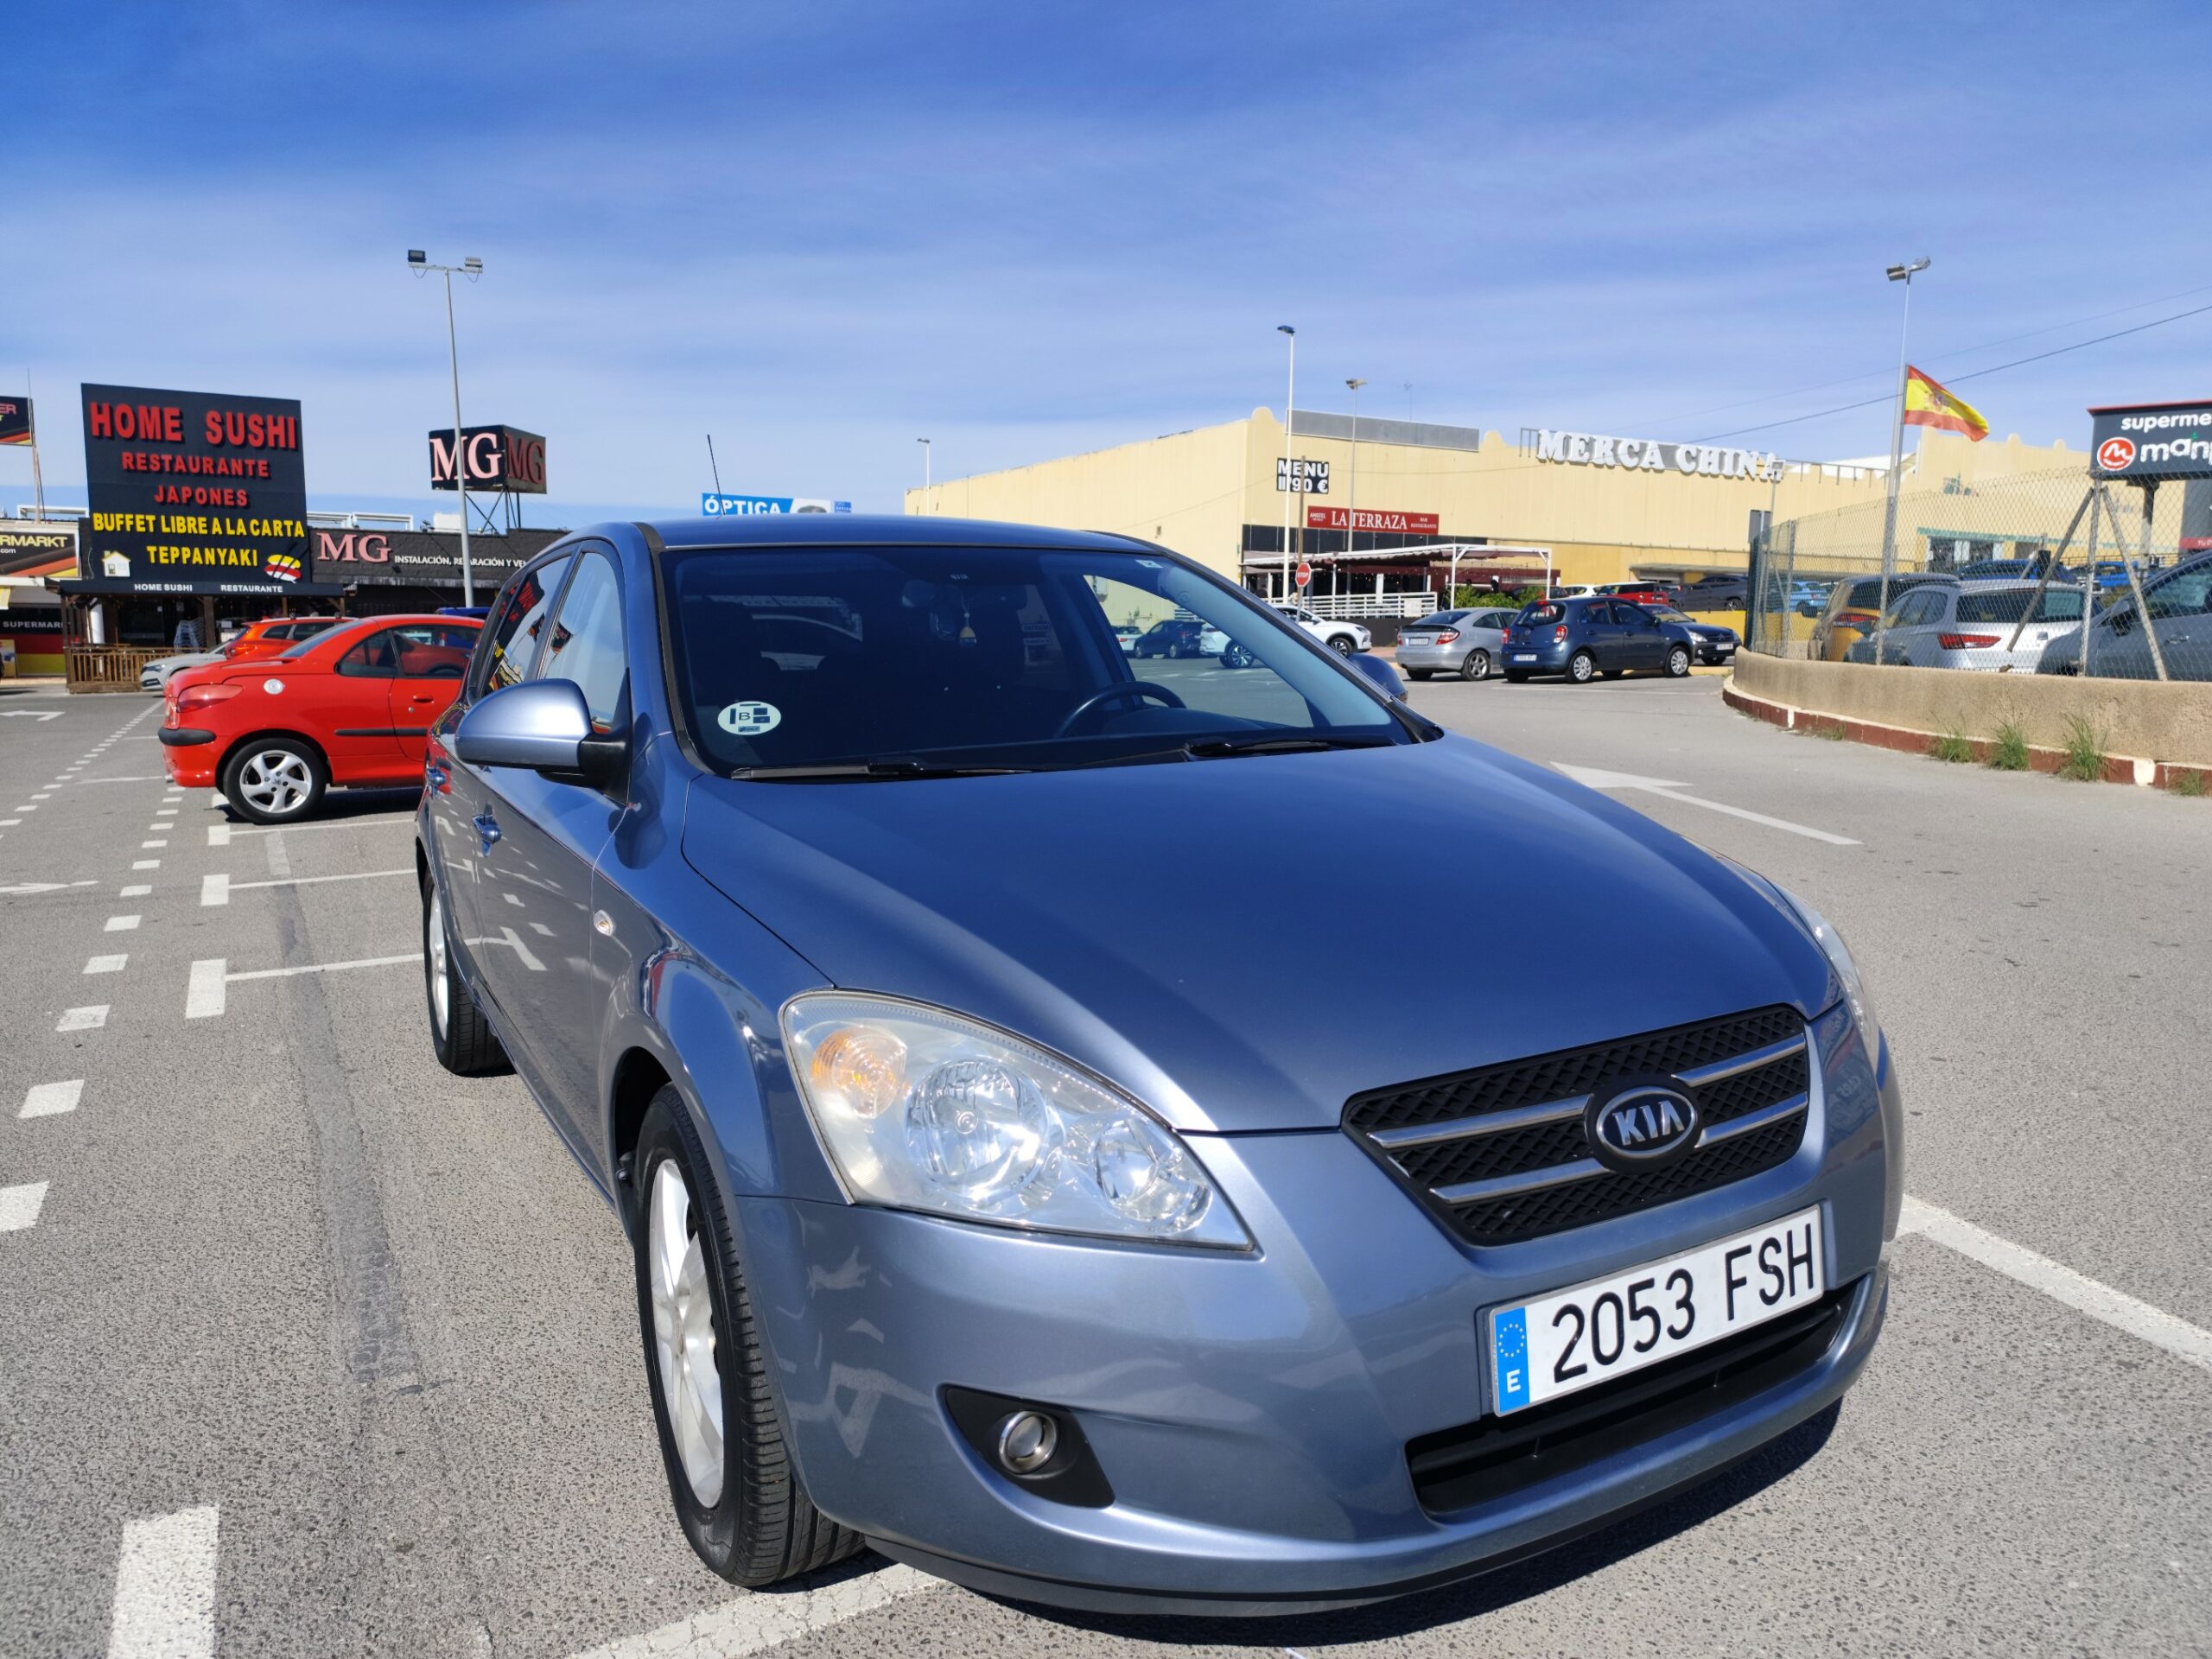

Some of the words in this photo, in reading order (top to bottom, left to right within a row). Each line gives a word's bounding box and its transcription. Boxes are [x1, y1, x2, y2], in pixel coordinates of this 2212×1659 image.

[90, 402, 182, 442] HOME
[206, 410, 296, 449] SUSHI
[122, 452, 270, 477] RESTAURANTE
[429, 433, 502, 481] MG
[505, 434, 545, 485] MG
[1538, 429, 1665, 471] MERCA
[1675, 443, 1785, 482] CHINA
[154, 485, 248, 506] JAPONES
[1318, 479, 1328, 493] €
[704, 495, 782, 514] ÓPTICA
[92, 512, 156, 532] BUFFET
[161, 515, 208, 534] LIBRE
[212, 518, 223, 535] A
[226, 518, 249, 536] LA
[250, 518, 304, 537] CARTA
[1332, 511, 1347, 526] LA
[1351, 512, 1408, 530] TERRAZA
[147, 546, 257, 566] TEPPANYAKI
[316, 532, 391, 563] MG
[394, 556, 452, 566] INSTALACIÓN,
[454, 557, 505, 567] REARACIÓN
[134, 583, 162, 592] HOME
[164, 583, 193, 592] SUSHI
[220, 584, 283, 593] RESTAURANTE
[738, 712, 750, 721] B
[1612, 1100, 1685, 1146] KIA
[1552, 1268, 1695, 1383] 2053
[1725, 1224, 1815, 1321] FSH
[1506, 1370, 1522, 1393] E
